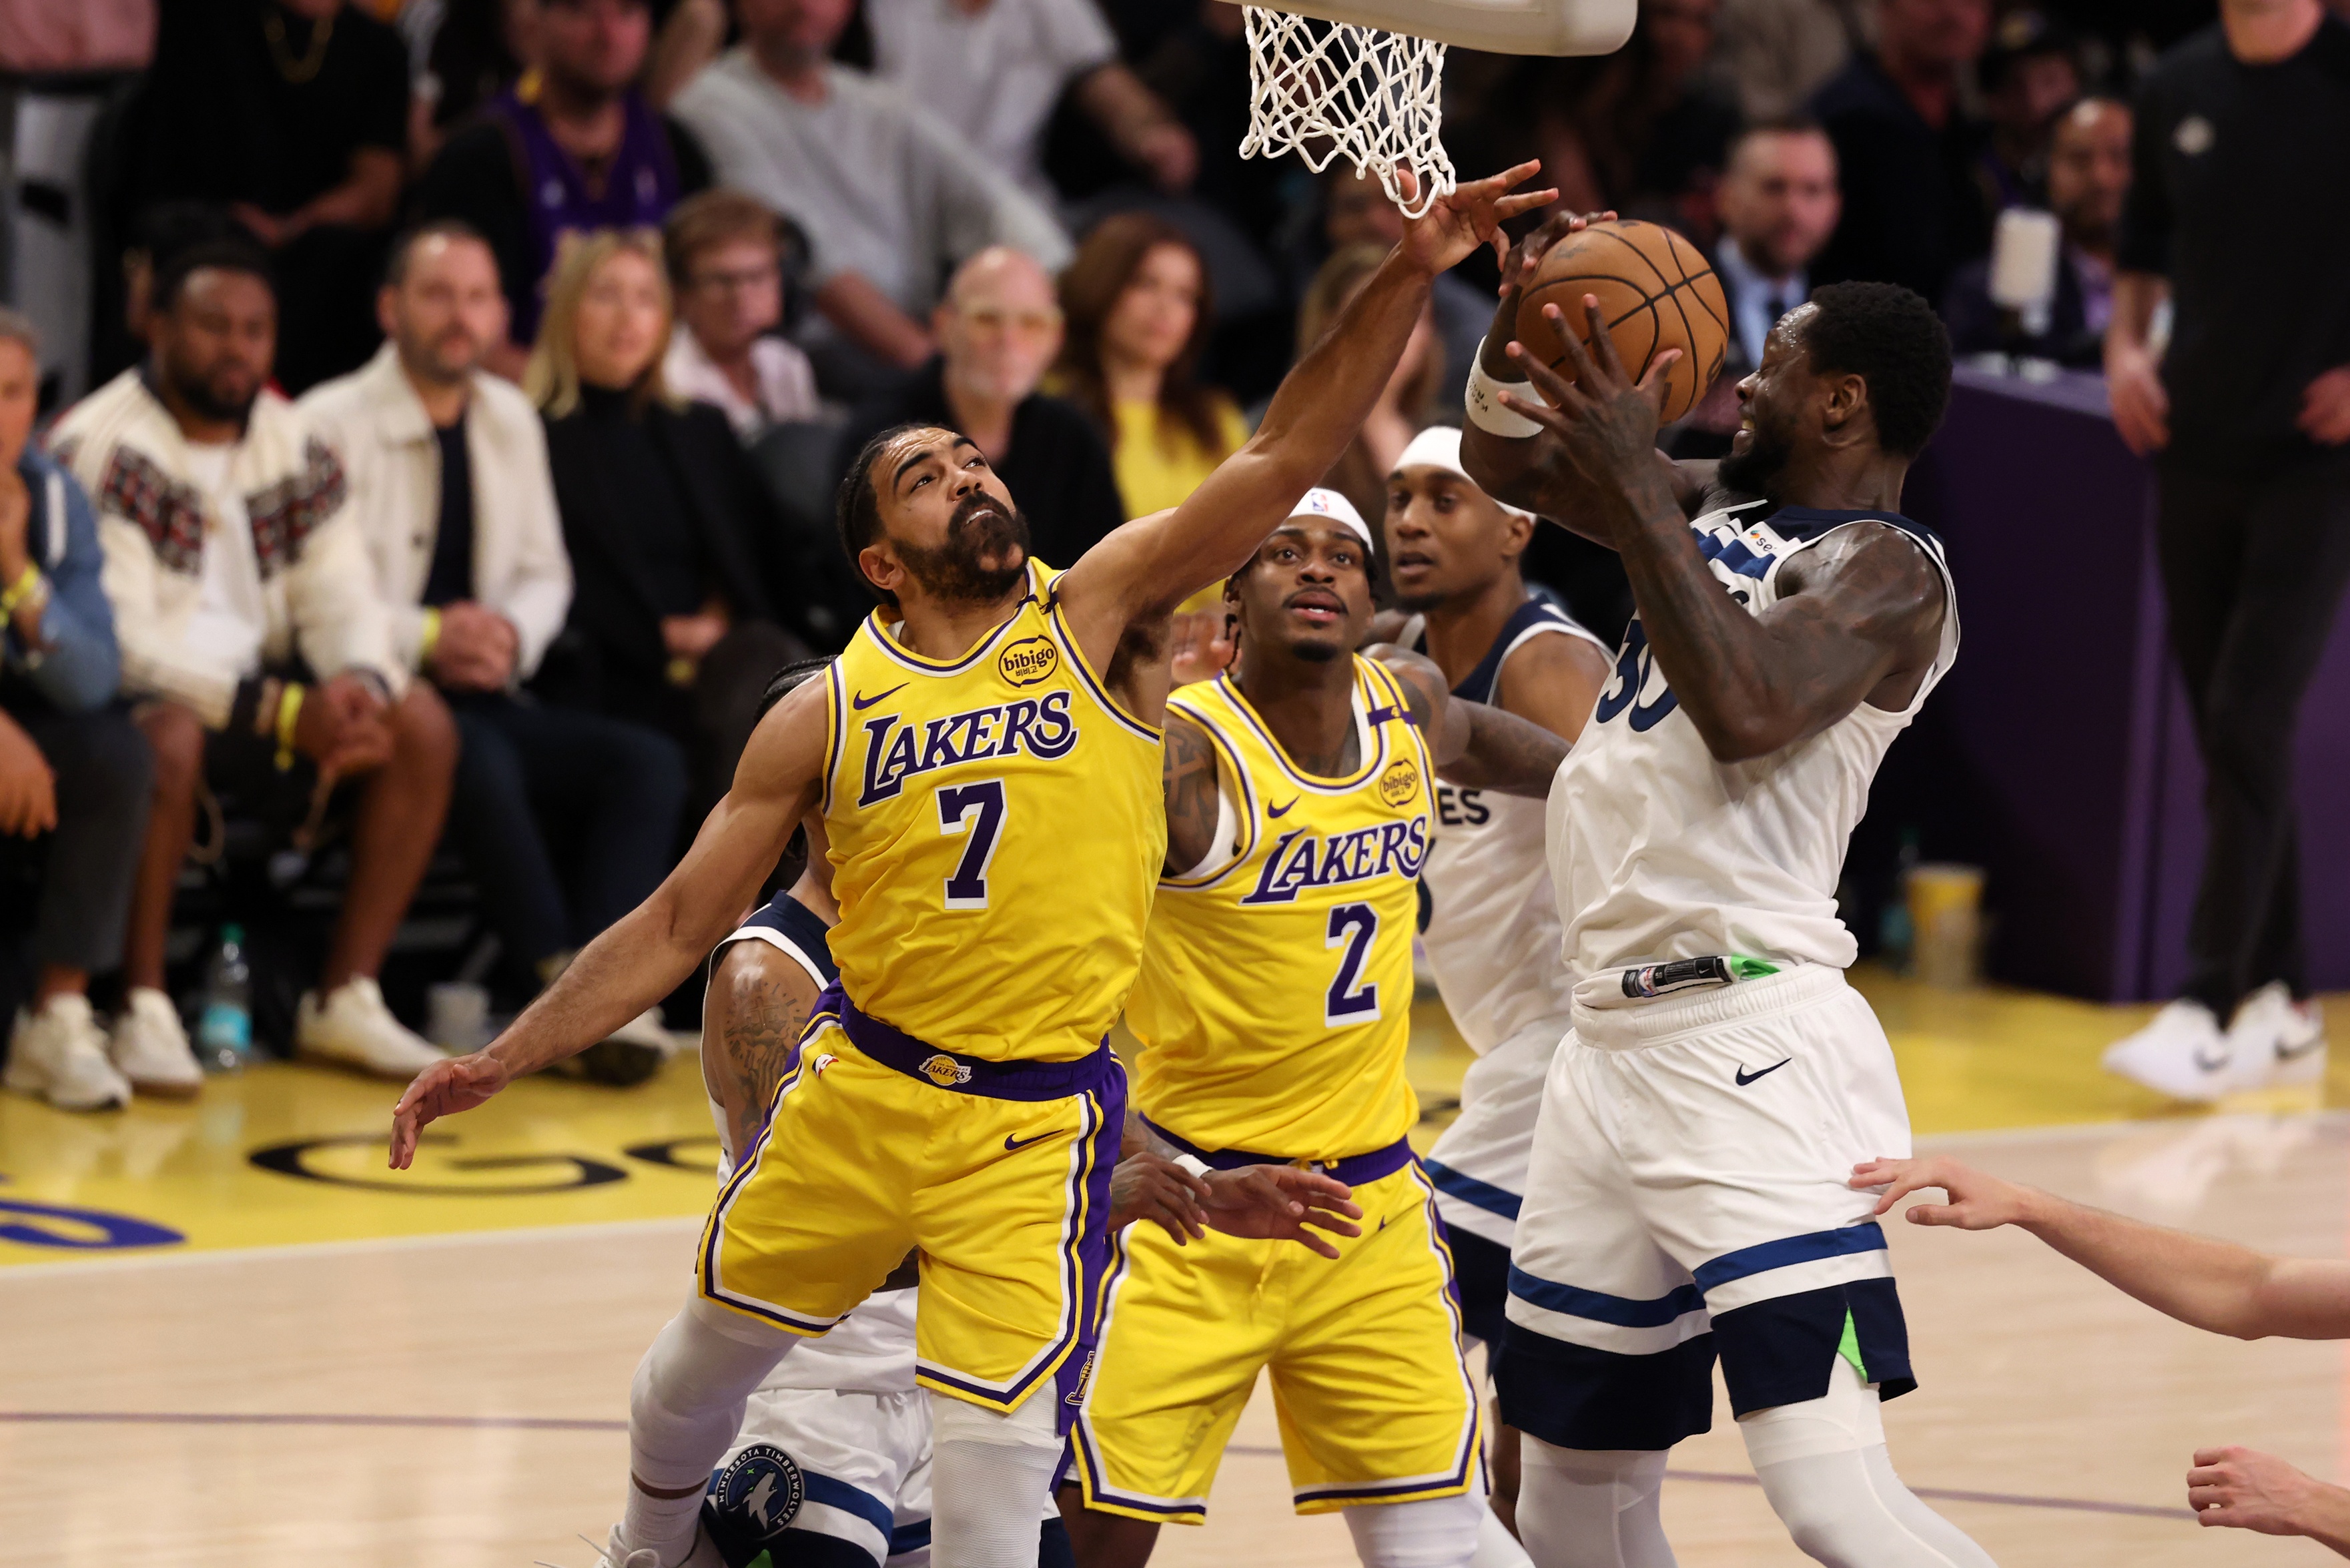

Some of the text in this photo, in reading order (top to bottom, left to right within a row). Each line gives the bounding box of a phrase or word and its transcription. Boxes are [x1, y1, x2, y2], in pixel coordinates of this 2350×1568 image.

[1003, 648, 1054, 671] bibigo
[1015, 665, 1038, 677] 비비고
[858, 690, 1079, 809] LAKERS
[1383, 771, 1415, 793] bibigo
[935, 777, 1008, 909] 7
[1238, 815, 1429, 906] LAKERS
[1324, 901, 1381, 1029] 2
[922, 1060, 970, 1082] LAKERS
[719, 1448, 800, 1526] MINNESOTA TIMBERWOLVES
